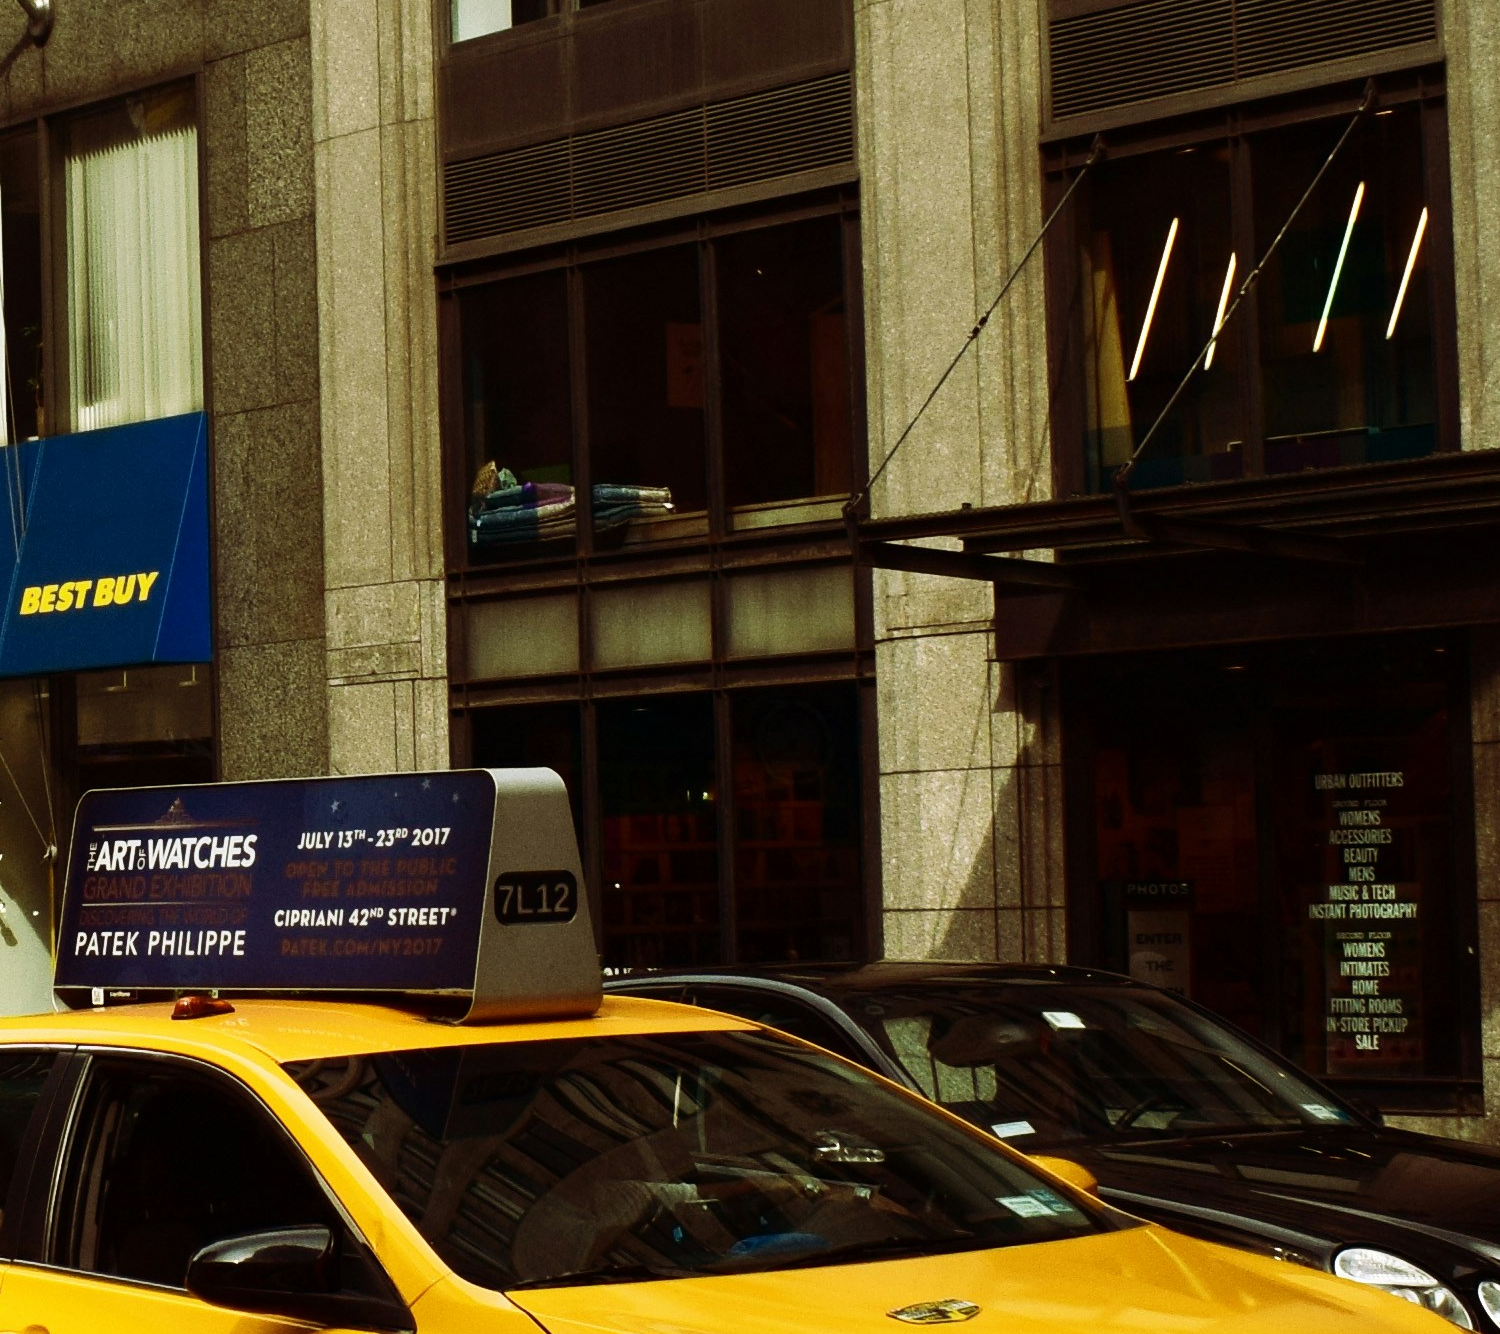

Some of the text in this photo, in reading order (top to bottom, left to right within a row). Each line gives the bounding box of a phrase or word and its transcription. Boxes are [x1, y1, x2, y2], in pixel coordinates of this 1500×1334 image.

[20, 572, 160, 615] BEST BUY
[1314, 772, 1404, 790] URBAN OUTFITTERS
[1338, 810, 1381, 826] WOMENS
[297, 831, 334, 850] JULY
[411, 828, 451, 847] 2017
[1329, 829, 1392, 845] ACCESSORIES
[87, 834, 258, 872] THE ART OF WATCHES
[1343, 848, 1379, 863] BEAUTY
[286, 857, 456, 878] OPEN TO THE PUBLIC
[1349, 866, 1375, 881] MENS
[83, 873, 252, 899] GRAND EXHIBITION
[303, 879, 439, 897] FREE ADMISSION
[1127, 883, 1189, 895] PHOTOS
[1329, 884, 1395, 900] MUSIC & TECH
[499, 882, 571, 915] 7L12
[274, 909, 344, 927] CIPRIANI
[348, 907, 384, 926] 42ND
[1309, 903, 1418, 919] INSTANT PHOTOGRAPHY
[75, 930, 247, 956] PATEK PHILIPPE
[1136, 933, 1183, 944] ENTER
[1343, 942, 1385, 957] WOMENS
[1146, 960, 1174, 971] THE
[1340, 961, 1390, 977] INTIMATES
[1352, 980, 1379, 995] HOME
[1331, 998, 1402, 1014] FITTING ROOMS
[1327, 1017, 1408, 1032] IN-STORE PICKUP
[1355, 1034, 1379, 1050] SALE
